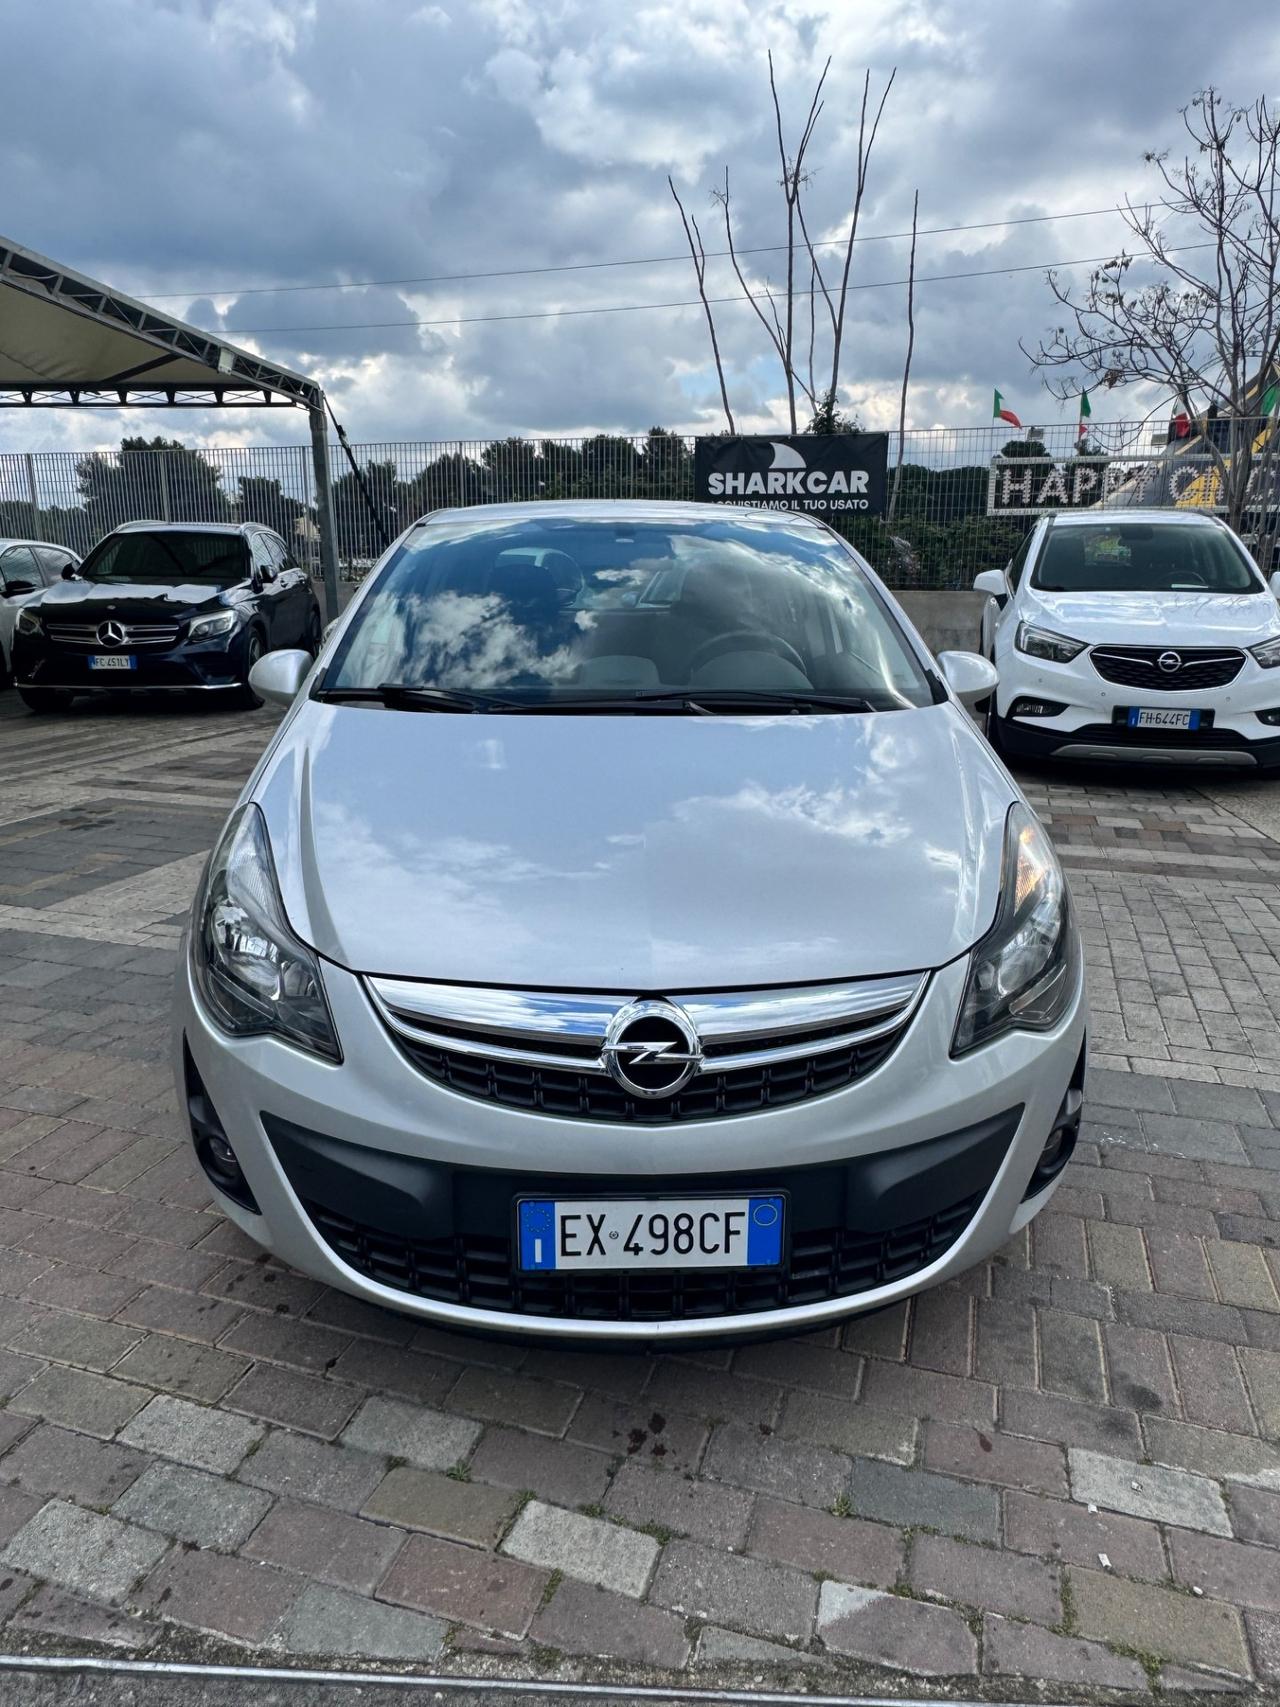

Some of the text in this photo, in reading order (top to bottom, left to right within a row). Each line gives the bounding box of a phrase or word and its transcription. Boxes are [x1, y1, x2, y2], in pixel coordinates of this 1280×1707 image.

[708, 470, 869, 495] SHARKCAR
[1002, 466, 1159, 503] HAPPY
[791, 500, 801, 510] IL
[804, 500, 826, 510] TUO
[830, 499, 869, 510] USATO
